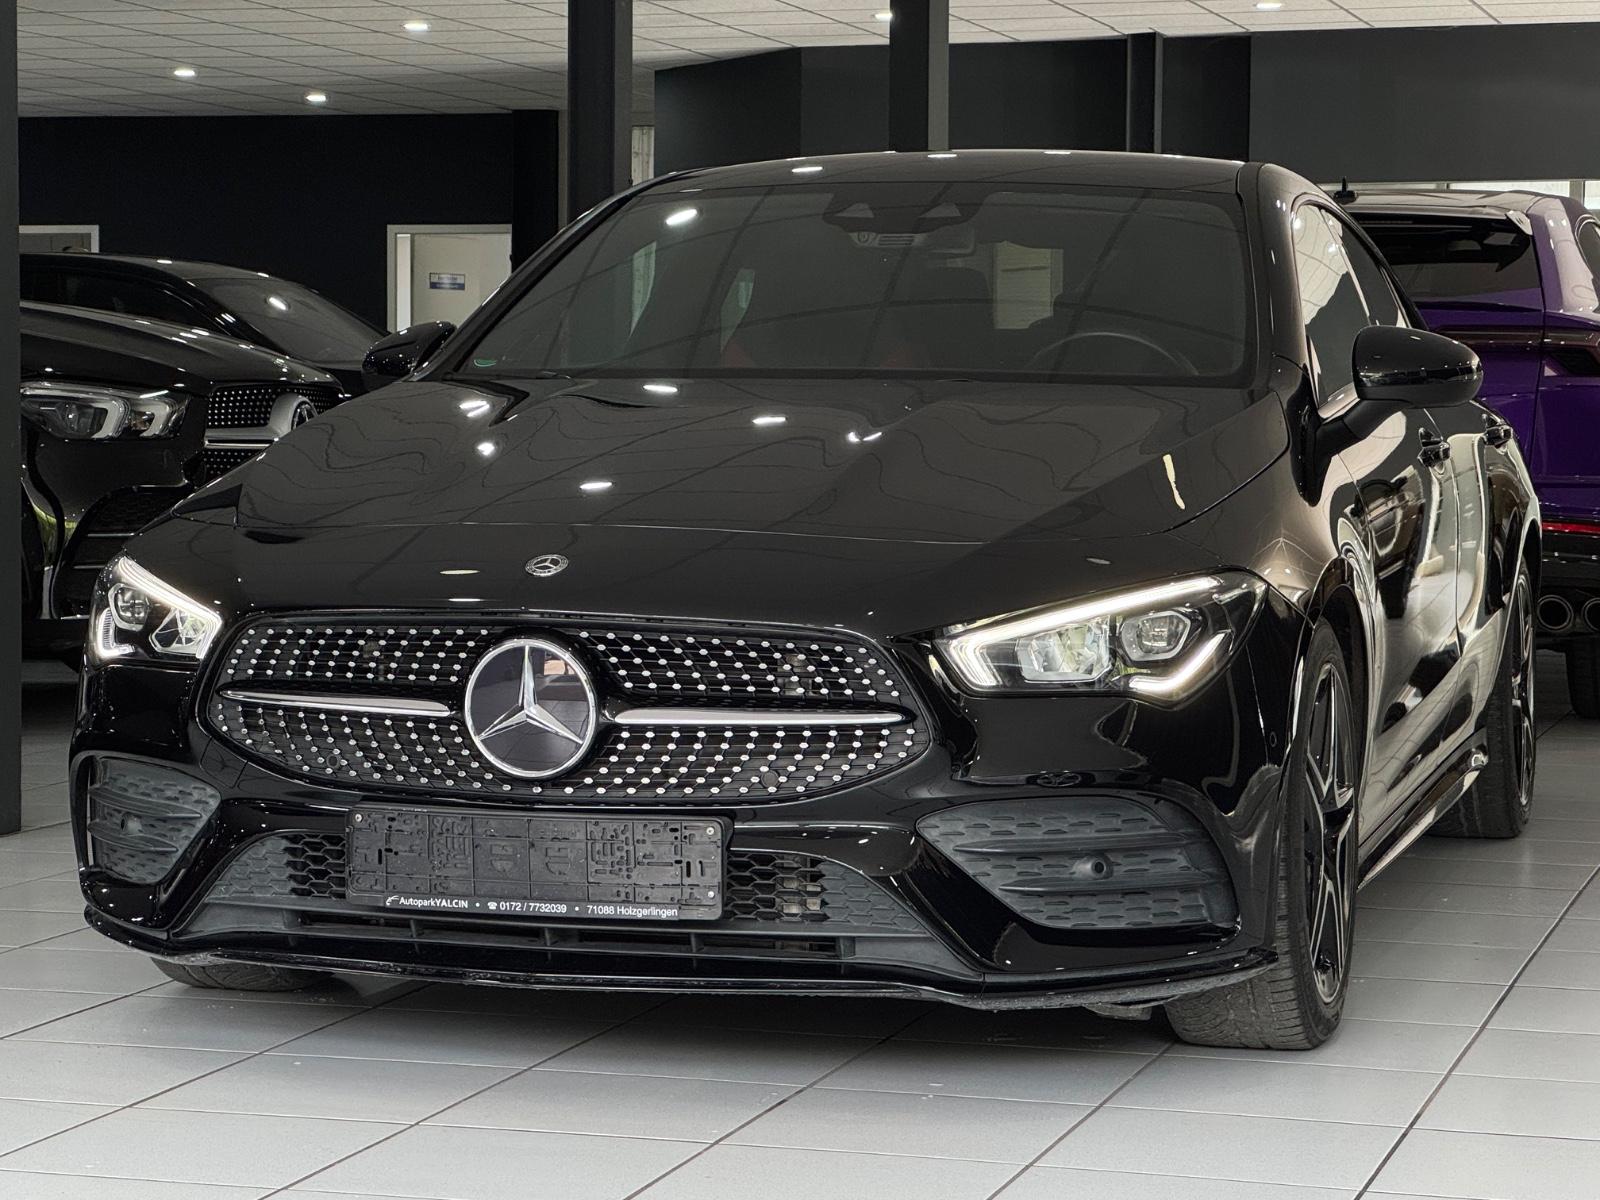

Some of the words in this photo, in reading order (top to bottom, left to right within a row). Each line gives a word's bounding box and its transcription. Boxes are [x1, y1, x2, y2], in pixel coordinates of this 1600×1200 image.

[499, 901, 522, 911] 0172
[529, 902, 567, 913] 7732039
[586, 904, 615, 915] 71088
[616, 905, 679, 918] Holzgerlingen
